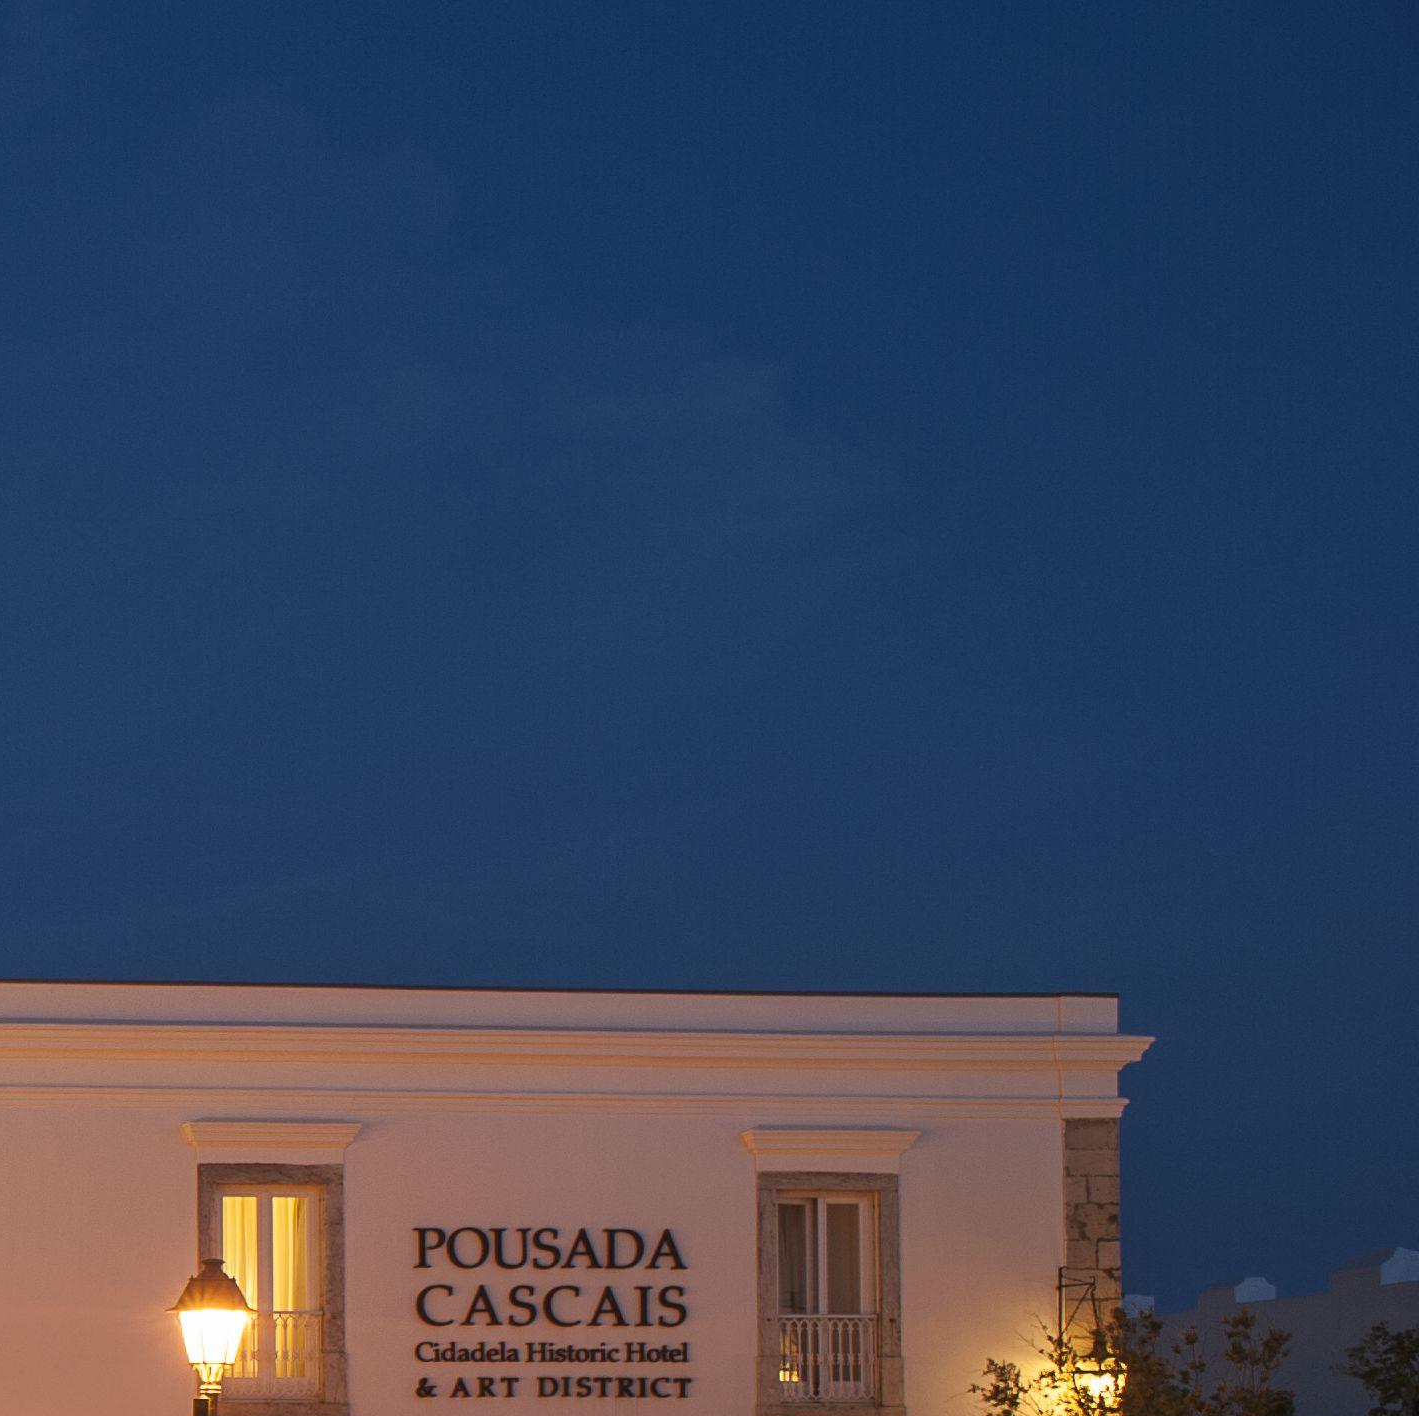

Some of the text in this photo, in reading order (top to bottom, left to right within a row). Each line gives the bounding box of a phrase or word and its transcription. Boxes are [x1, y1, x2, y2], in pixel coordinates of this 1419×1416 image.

[412, 1226, 689, 1271] POUSADA
[415, 1284, 688, 1328] CASCAIS
[414, 1341, 690, 1364] Cidadela Historic Hotel
[415, 1376, 693, 1399] & ART DISTRICT
